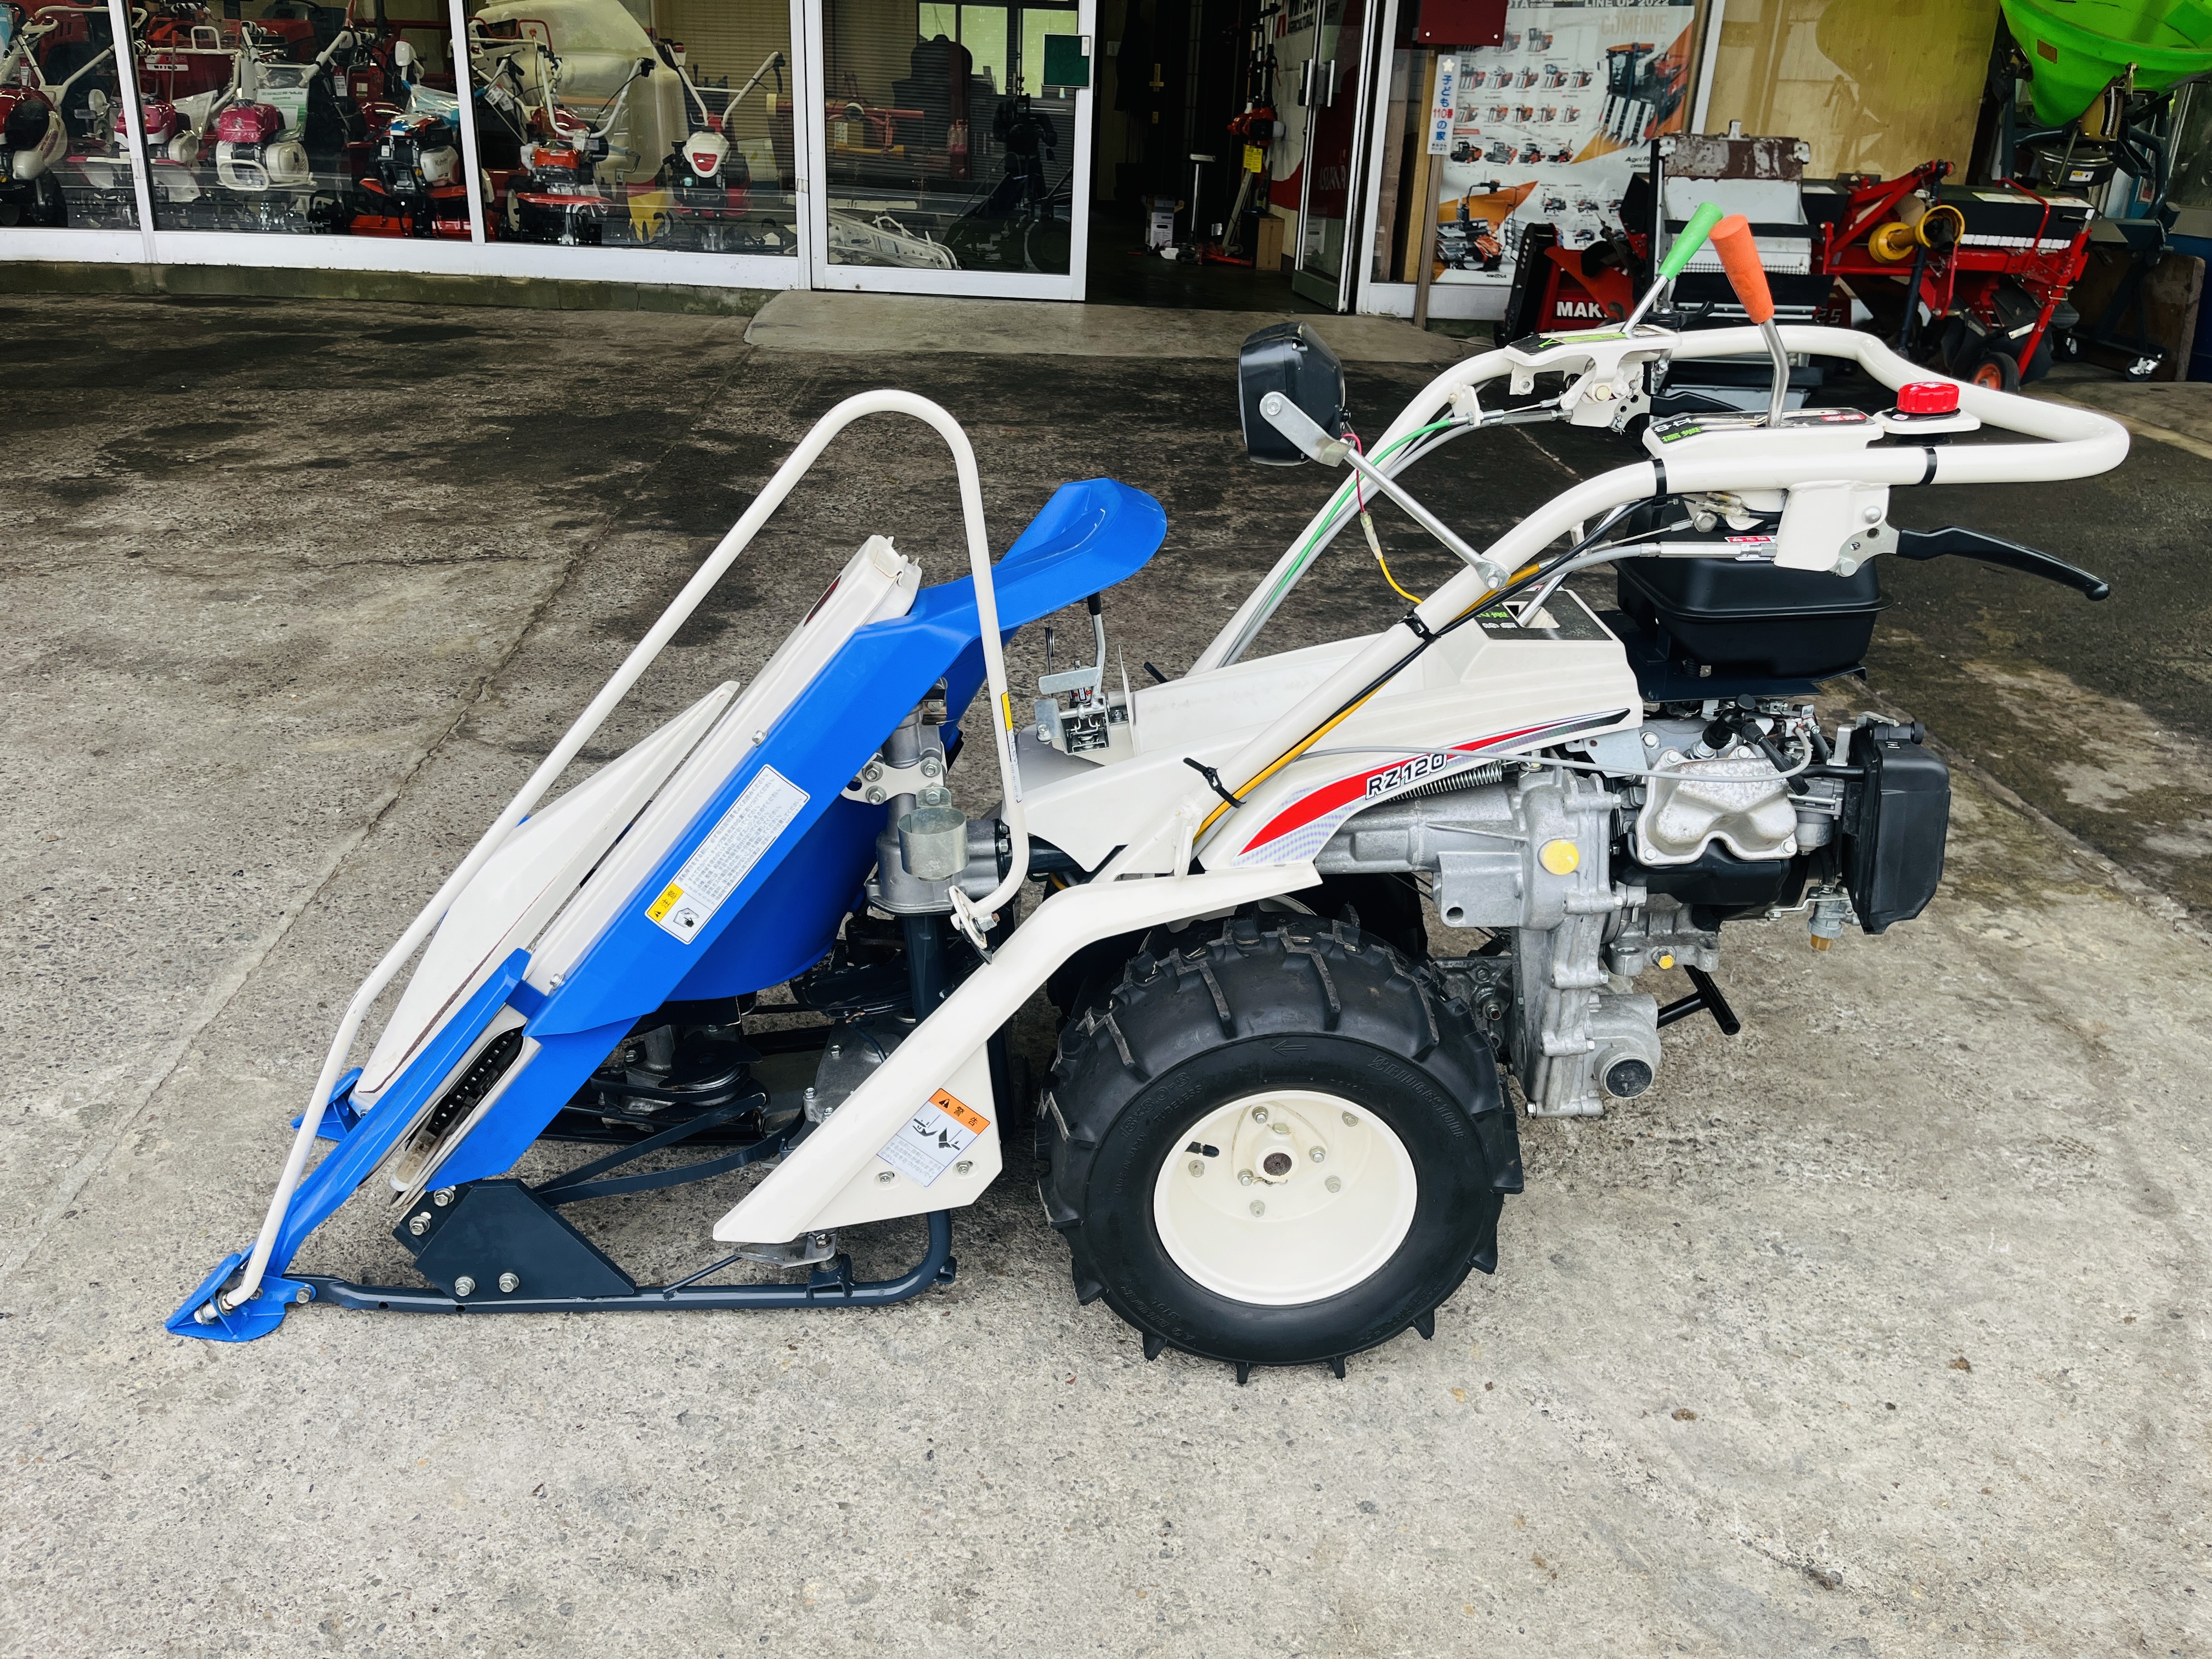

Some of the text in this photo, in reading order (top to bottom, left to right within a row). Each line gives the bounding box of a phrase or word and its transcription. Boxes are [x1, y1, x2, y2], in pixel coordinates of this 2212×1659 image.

[1556, 301, 1608, 318] MAK
[1366, 753, 1447, 800] RZ120
[660, 889, 677, 909] 注意
[954, 1106, 979, 1126] 警告
[1153, 1084, 1203, 1124] TUBELESS
[1367, 1055, 1467, 1141] BRIDGESTONE
[1114, 1131, 1148, 1195] MADE IN JAPAN
[1120, 1285, 1170, 1328] BINDER
